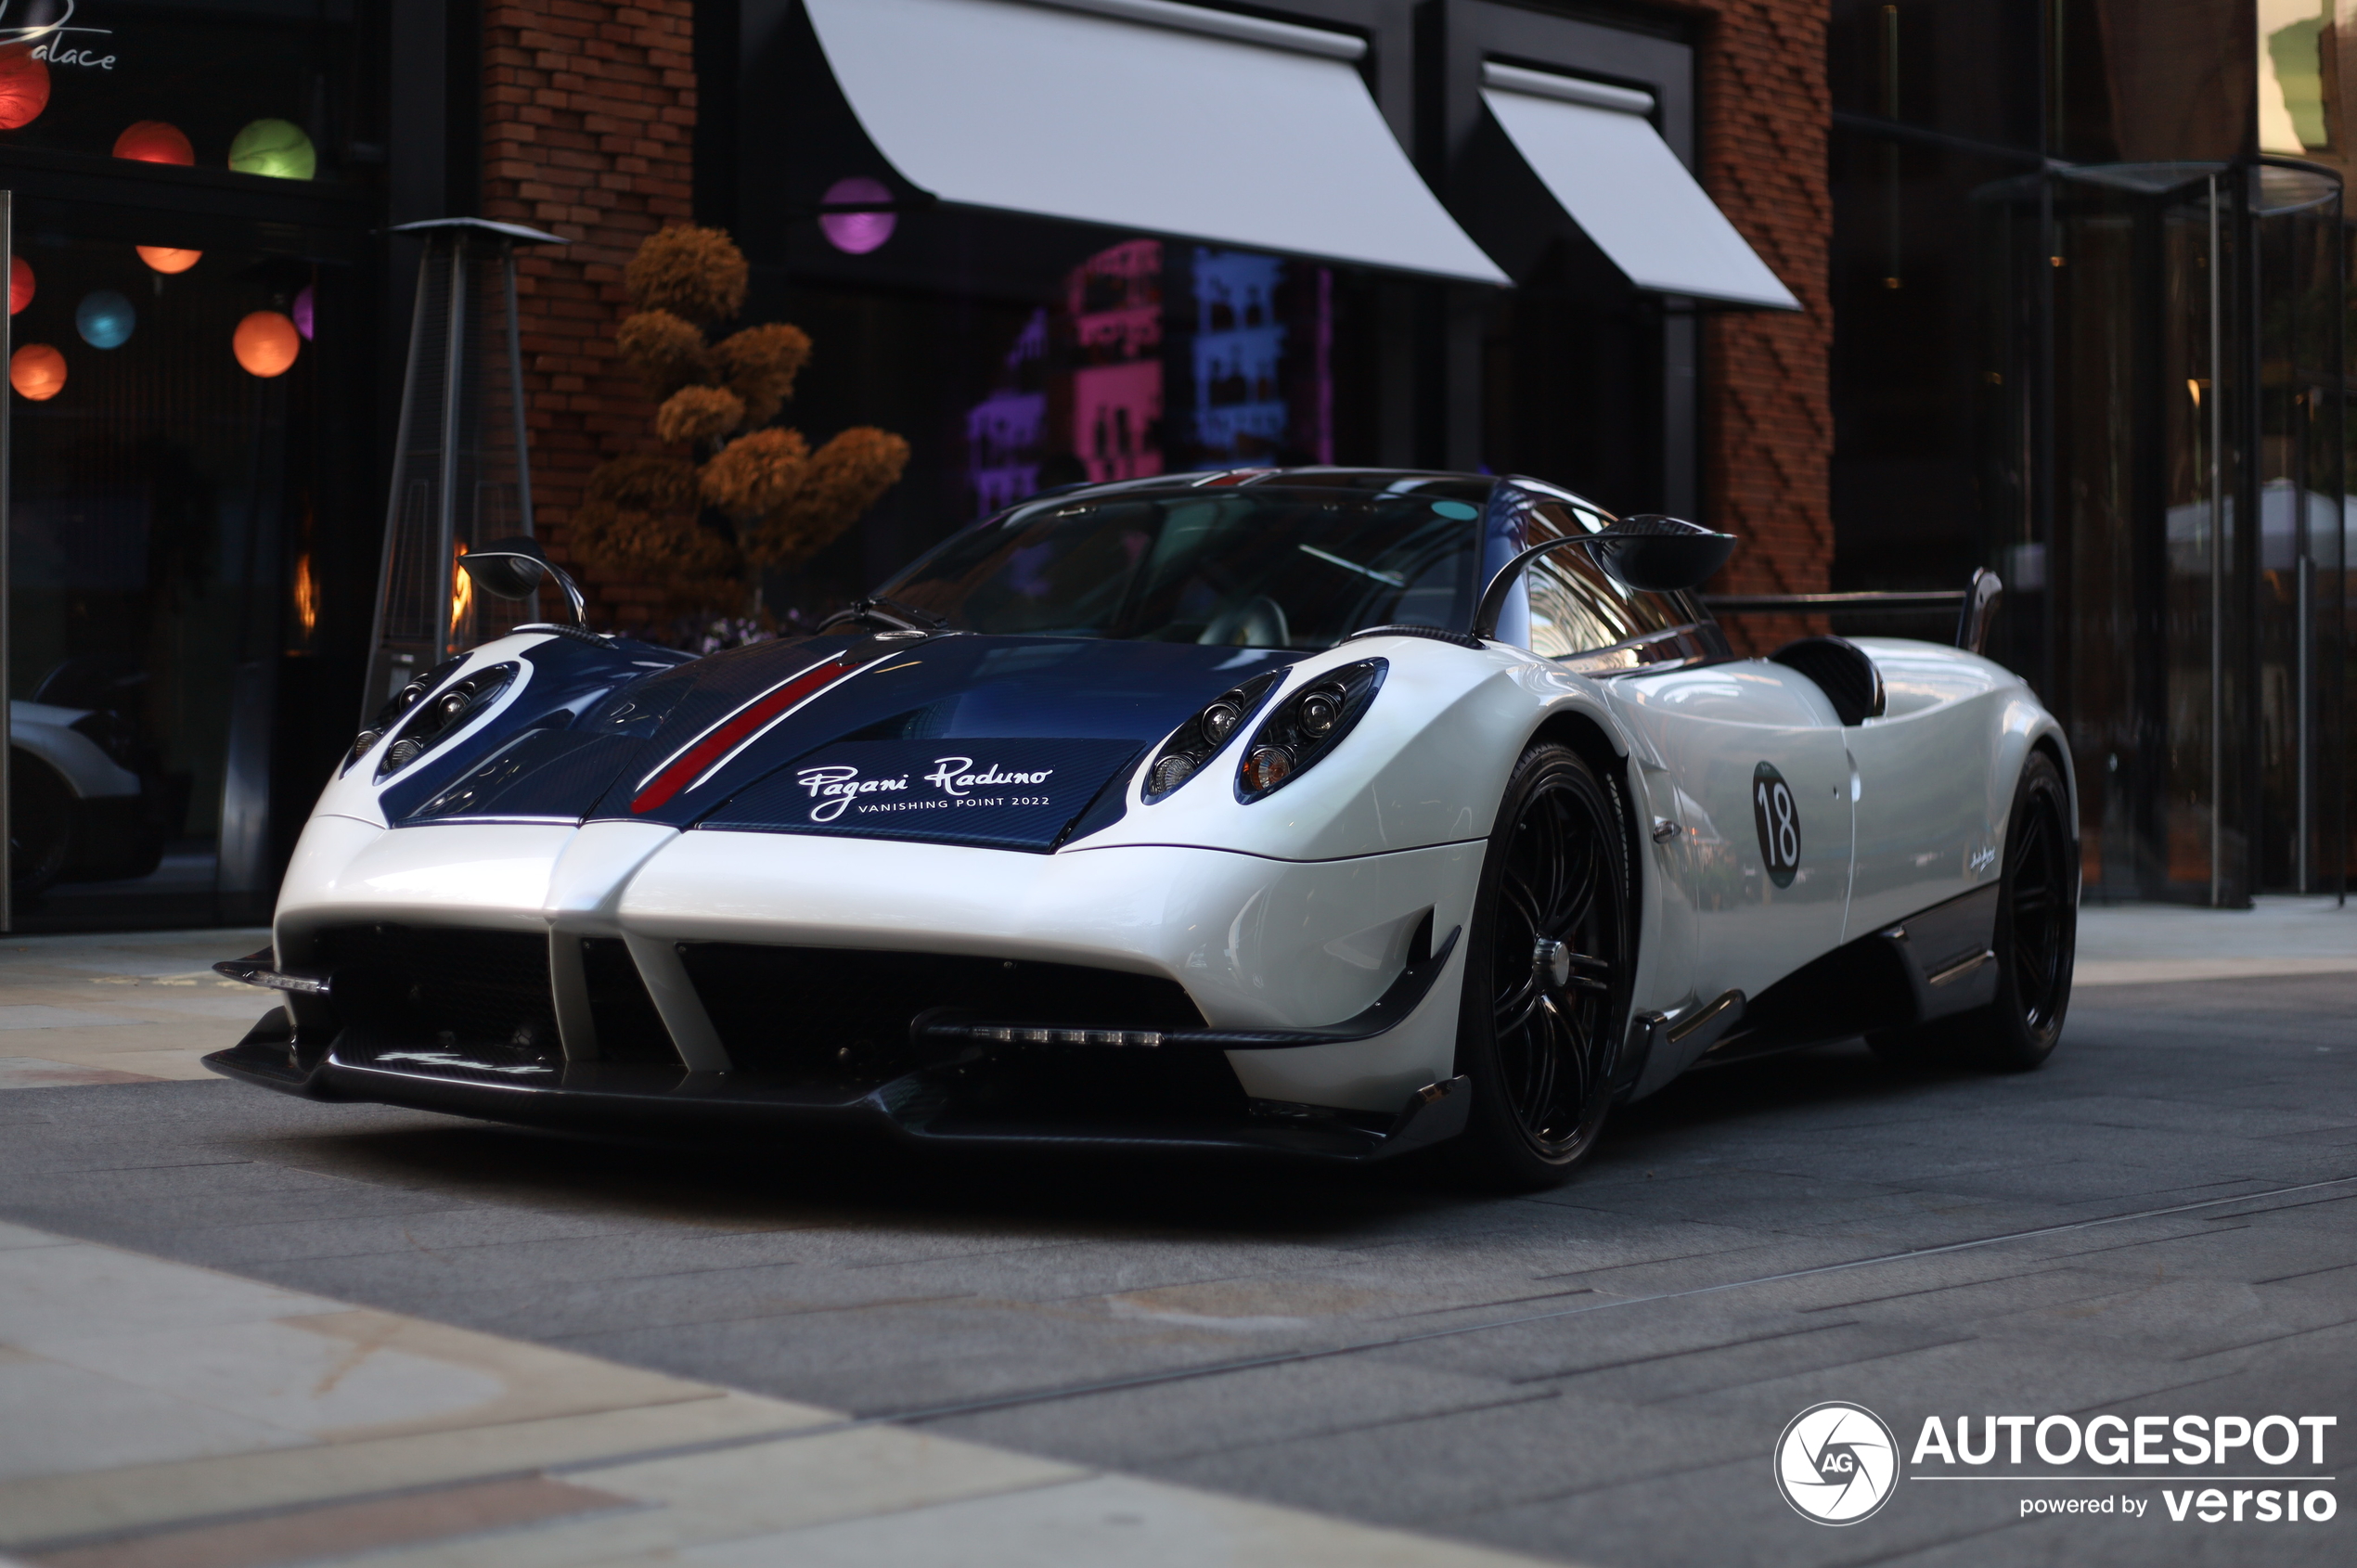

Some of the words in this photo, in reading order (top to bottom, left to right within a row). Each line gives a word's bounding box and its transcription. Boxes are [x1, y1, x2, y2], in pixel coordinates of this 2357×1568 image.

[796, 765, 909, 822] Pagani
[924, 756, 1053, 796] Raduno
[858, 799, 948, 813] VANISHING
[956, 797, 1004, 807] POINT
[1011, 796, 1050, 805] 2022
[1758, 781, 1798, 868] 18
